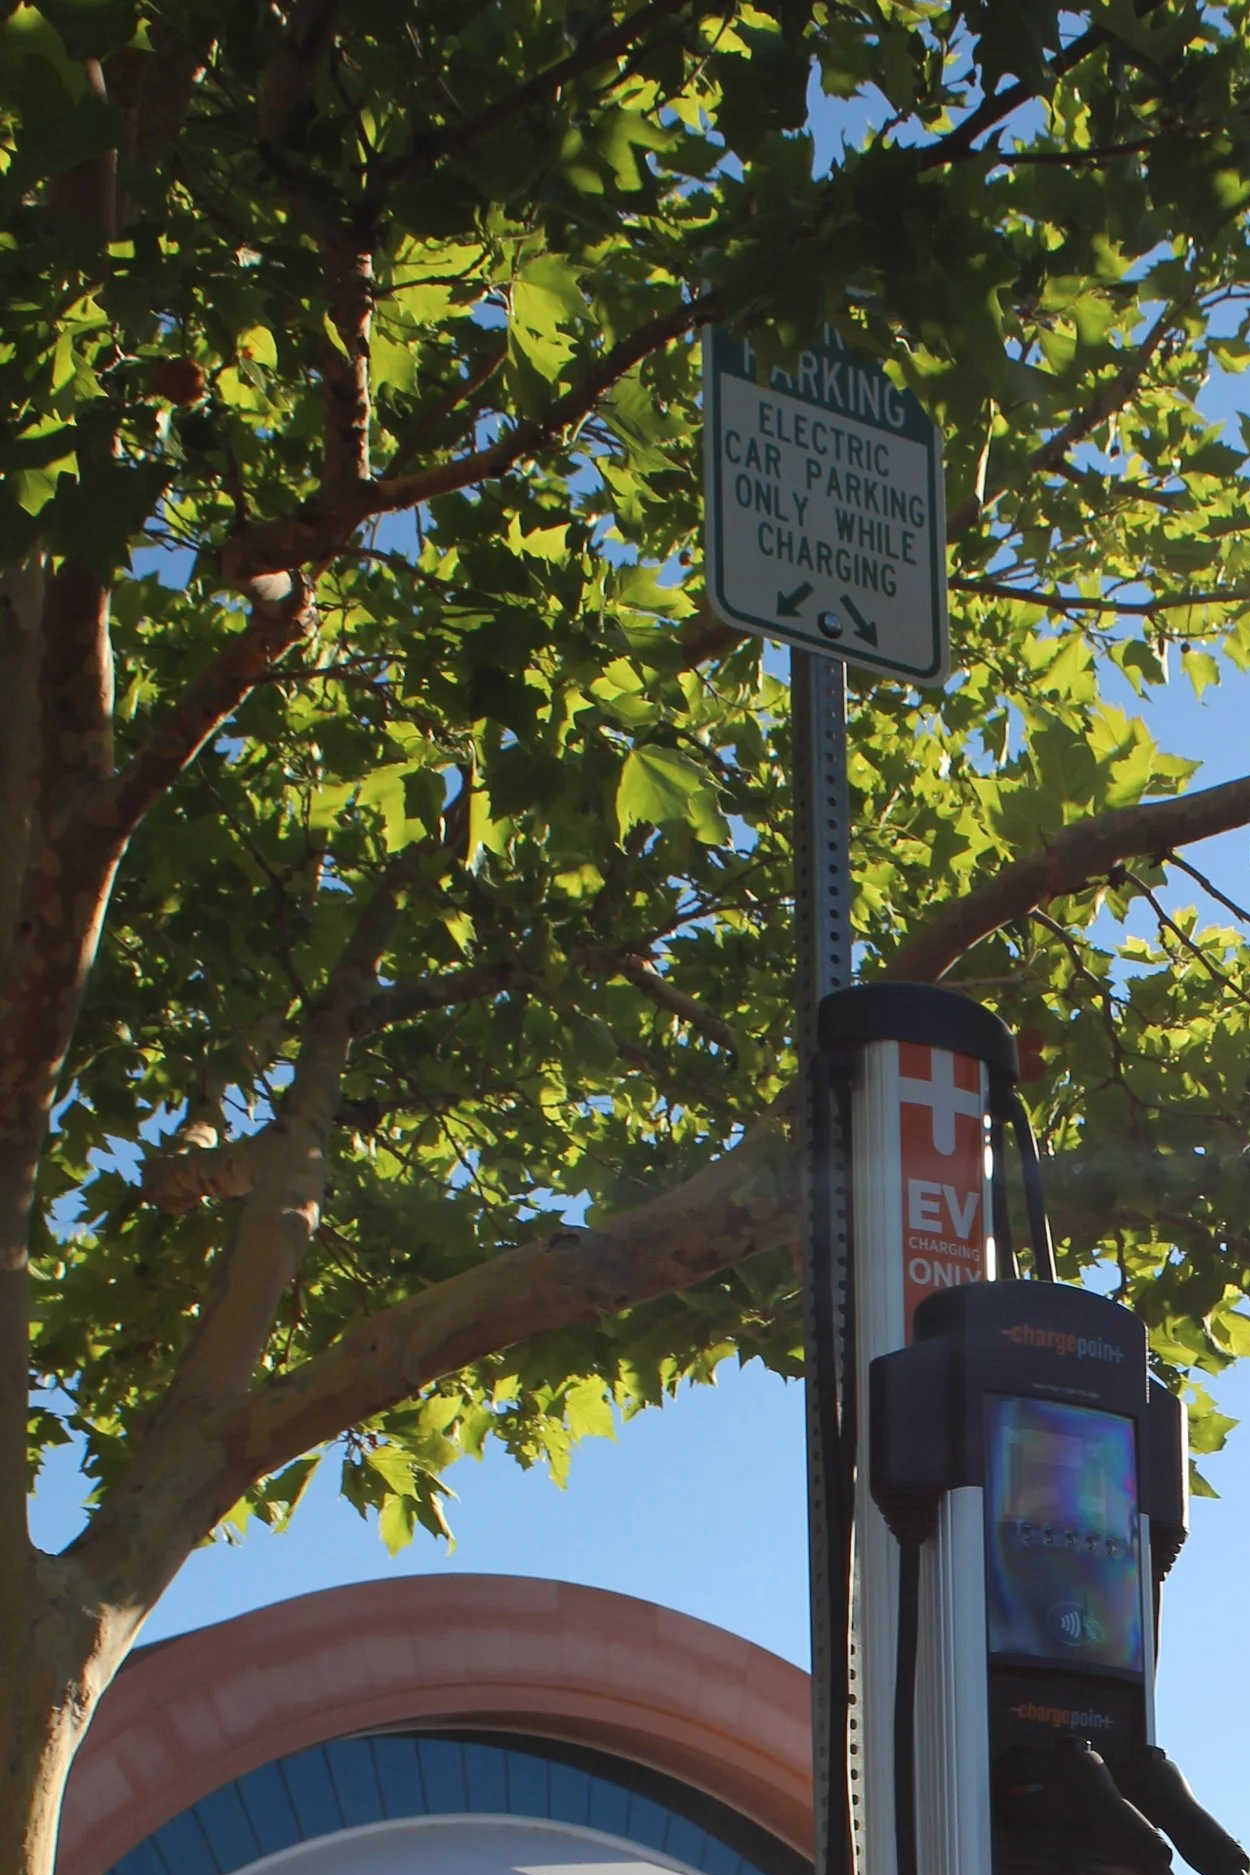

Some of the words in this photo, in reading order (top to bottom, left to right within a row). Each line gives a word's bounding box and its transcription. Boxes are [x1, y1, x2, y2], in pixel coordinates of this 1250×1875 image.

[758, 400, 890, 478] ELECTRIC
[725, 429, 782, 480] CAR
[805, 458, 925, 529] PARKING
[734, 472, 810, 528] ONLY
[835, 507, 917, 566] WHILE
[757, 522, 897, 598] CHARGING
[907, 1178, 980, 1240] EV
[908, 1236, 981, 1262] CHARGING
